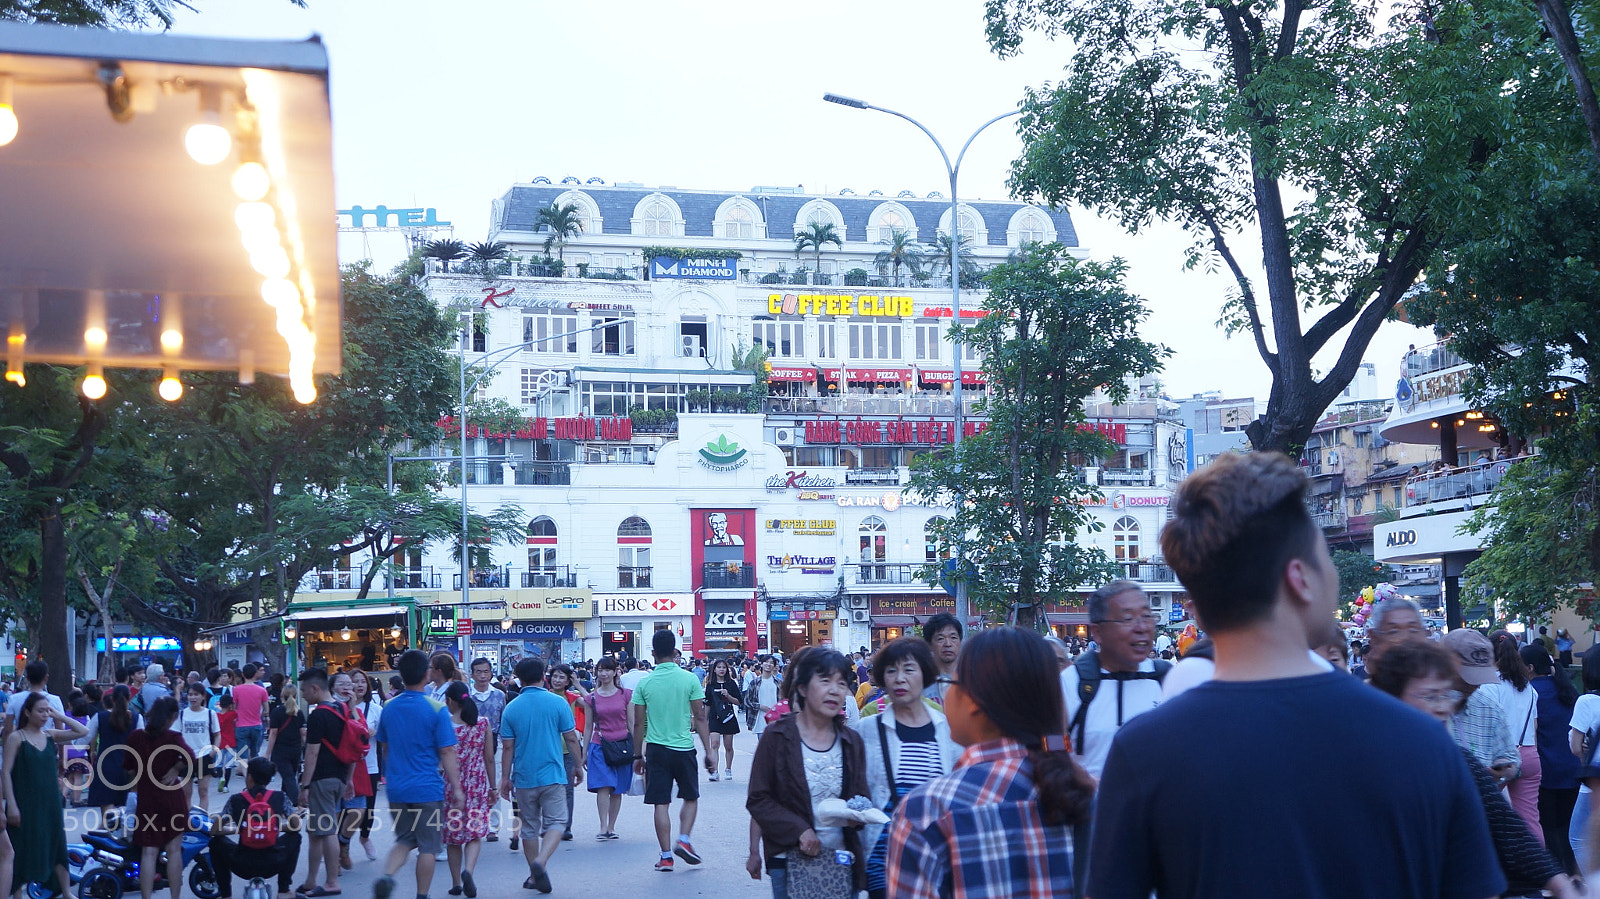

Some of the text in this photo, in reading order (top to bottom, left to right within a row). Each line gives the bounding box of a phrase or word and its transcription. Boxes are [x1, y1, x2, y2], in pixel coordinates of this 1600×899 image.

[687, 259, 727, 267] MINH
[681, 268, 733, 277] DIAMOND
[481, 287, 561, 308] Kitchen
[768, 294, 914, 317] COFFEE CLUB
[770, 370, 803, 378] COFFEE
[830, 371, 900, 379] STAK PIZZA
[555, 412, 596, 440] MUÔN
[601, 412, 632, 440] NĂM
[805, 415, 841, 443] ĐẢNG
[846, 416, 881, 447] CỘNG
[887, 414, 913, 443] SẢN
[916, 416, 943, 447] VIỆT
[697, 458, 749, 472] PHYTOPHARCO
[766, 473, 786, 487] the
[786, 470, 835, 488] Kitchen
[1130, 497, 1169, 506] DONUTS
[766, 519, 836, 529] COFFEE CLUB
[1386, 529, 1417, 547] ALDO
[512, 602, 541, 610] Canon
[545, 596, 585, 605] GoPro
[604, 598, 648, 612] HSBC
[930, 599, 955, 608] Coffee
[430, 615, 454, 628] aha
[705, 612, 746, 627] KFC
[525, 624, 565, 634] Galaxy
